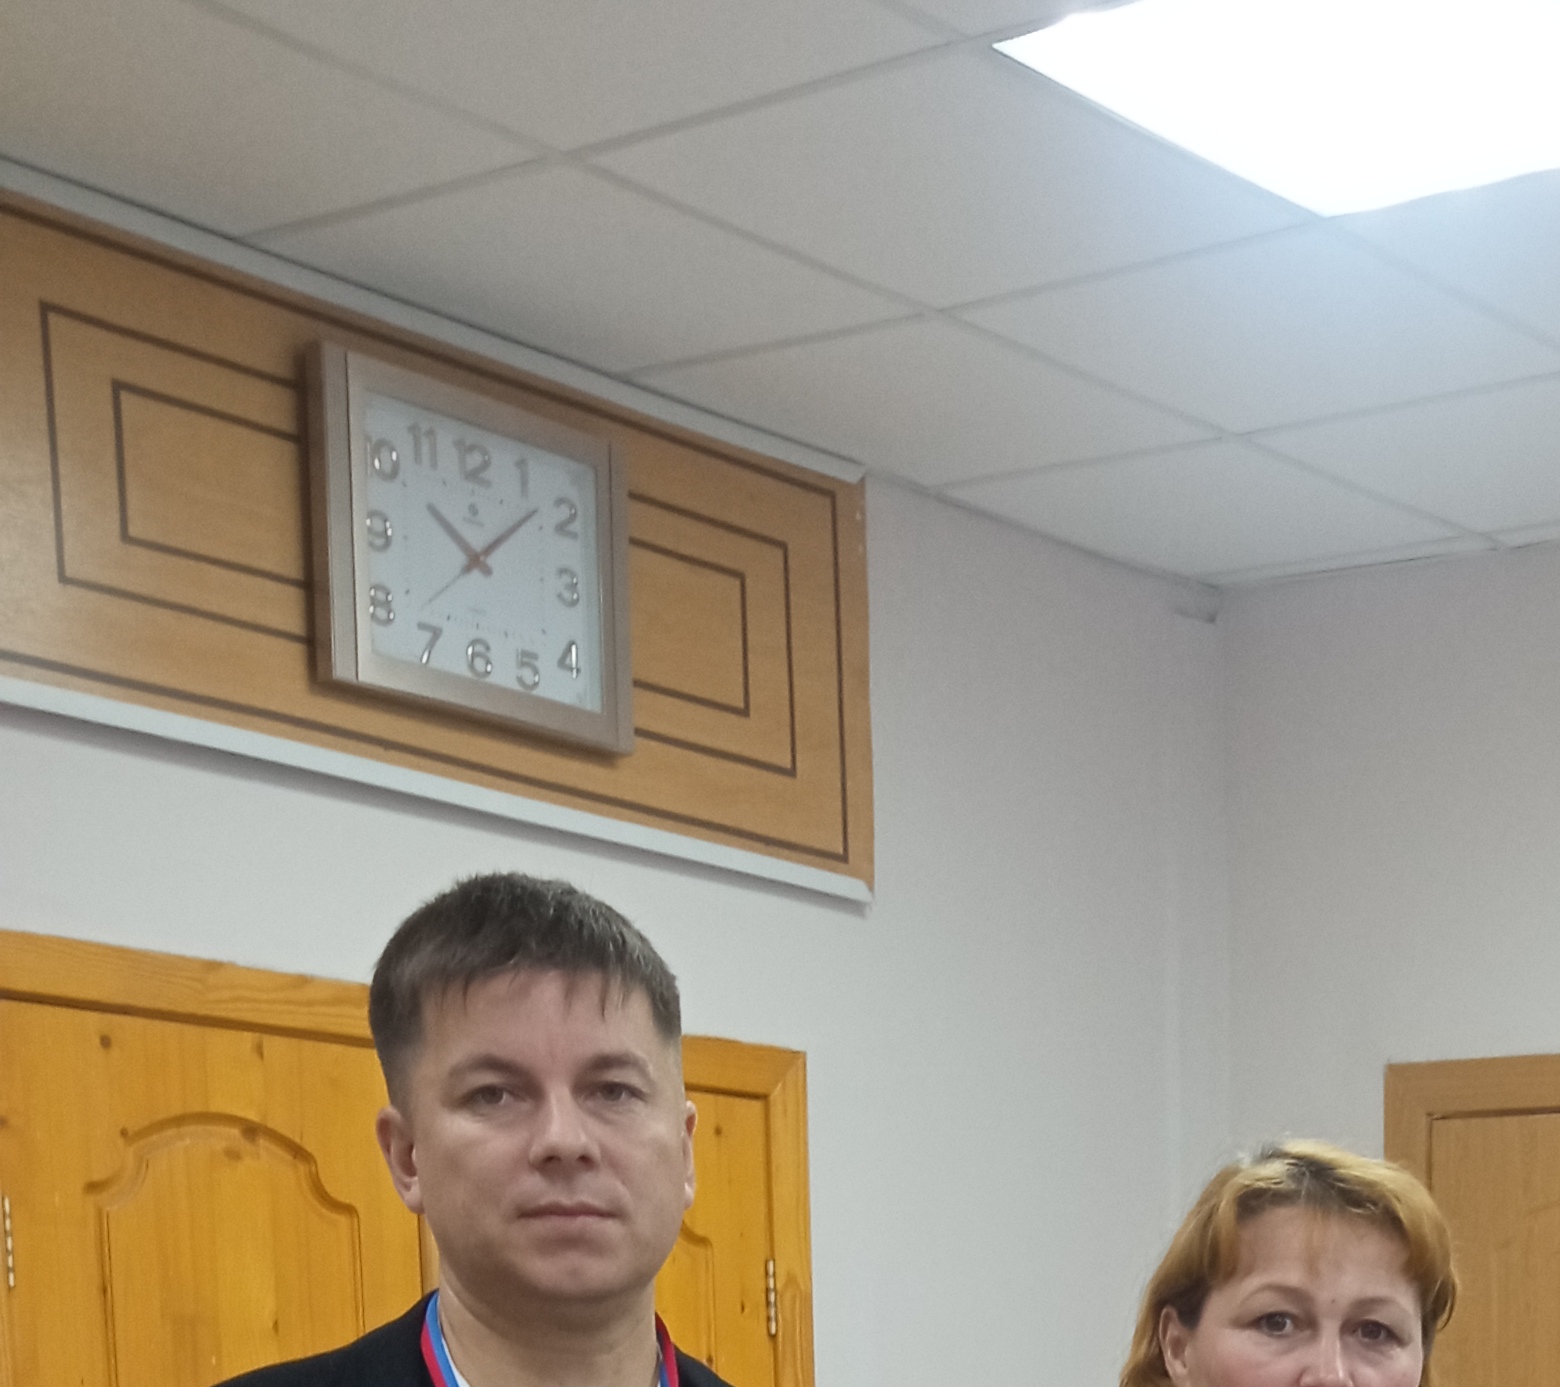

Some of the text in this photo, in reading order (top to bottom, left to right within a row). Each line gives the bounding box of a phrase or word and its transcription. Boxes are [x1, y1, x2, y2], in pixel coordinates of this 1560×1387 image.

[407, 421, 438, 470] 11
[453, 437, 492, 488] 12
[514, 457, 529, 499] 1
[366, 509, 393, 552] 9
[553, 497, 578, 540] 2
[368, 583, 395, 626] 8
[556, 567, 580, 608] 3
[416, 621, 443, 665] 7
[466, 637, 493, 680] 6
[556, 639, 580, 680] 4
[515, 648, 540, 691] 5
